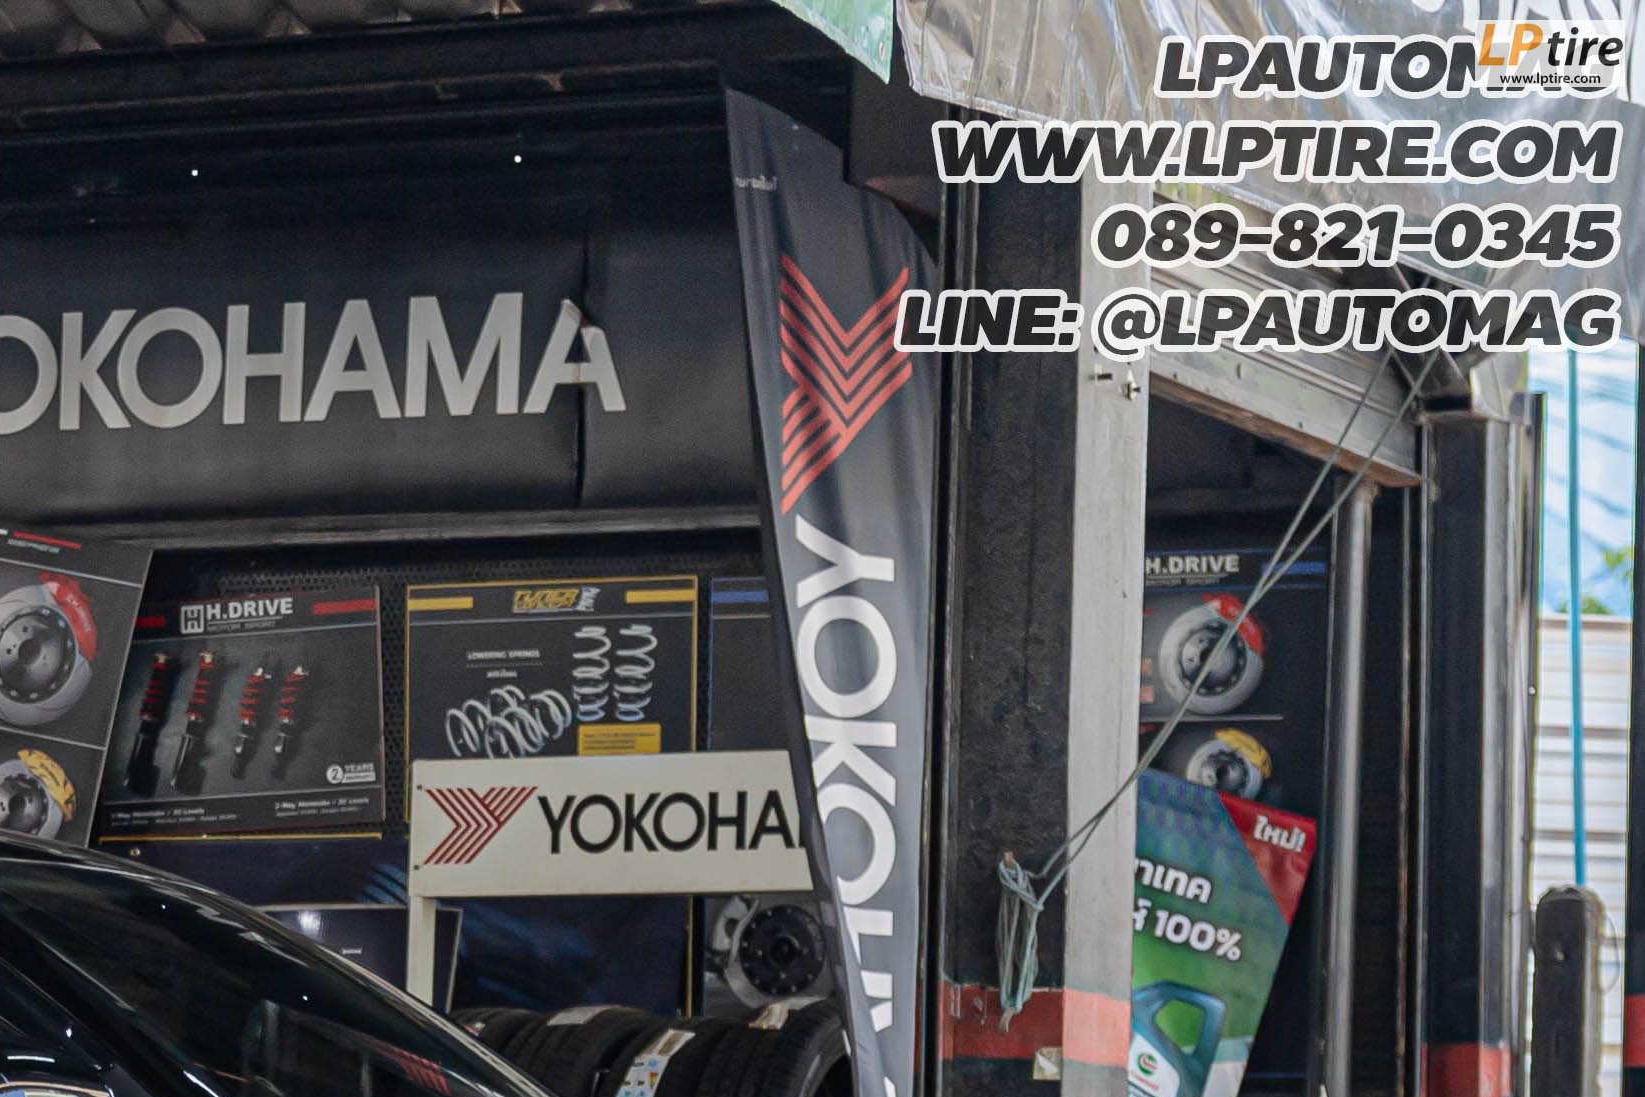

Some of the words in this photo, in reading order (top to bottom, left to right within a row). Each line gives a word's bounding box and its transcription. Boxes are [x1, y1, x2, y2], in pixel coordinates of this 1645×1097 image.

[1145, 554, 1240, 576] H.DRIVE
[206, 597, 294, 621] H.DRIVE
[794, 514, 899, 1035] YOKO
[537, 789, 806, 856] YOKOHA
[1154, 910, 1242, 961] 100%
